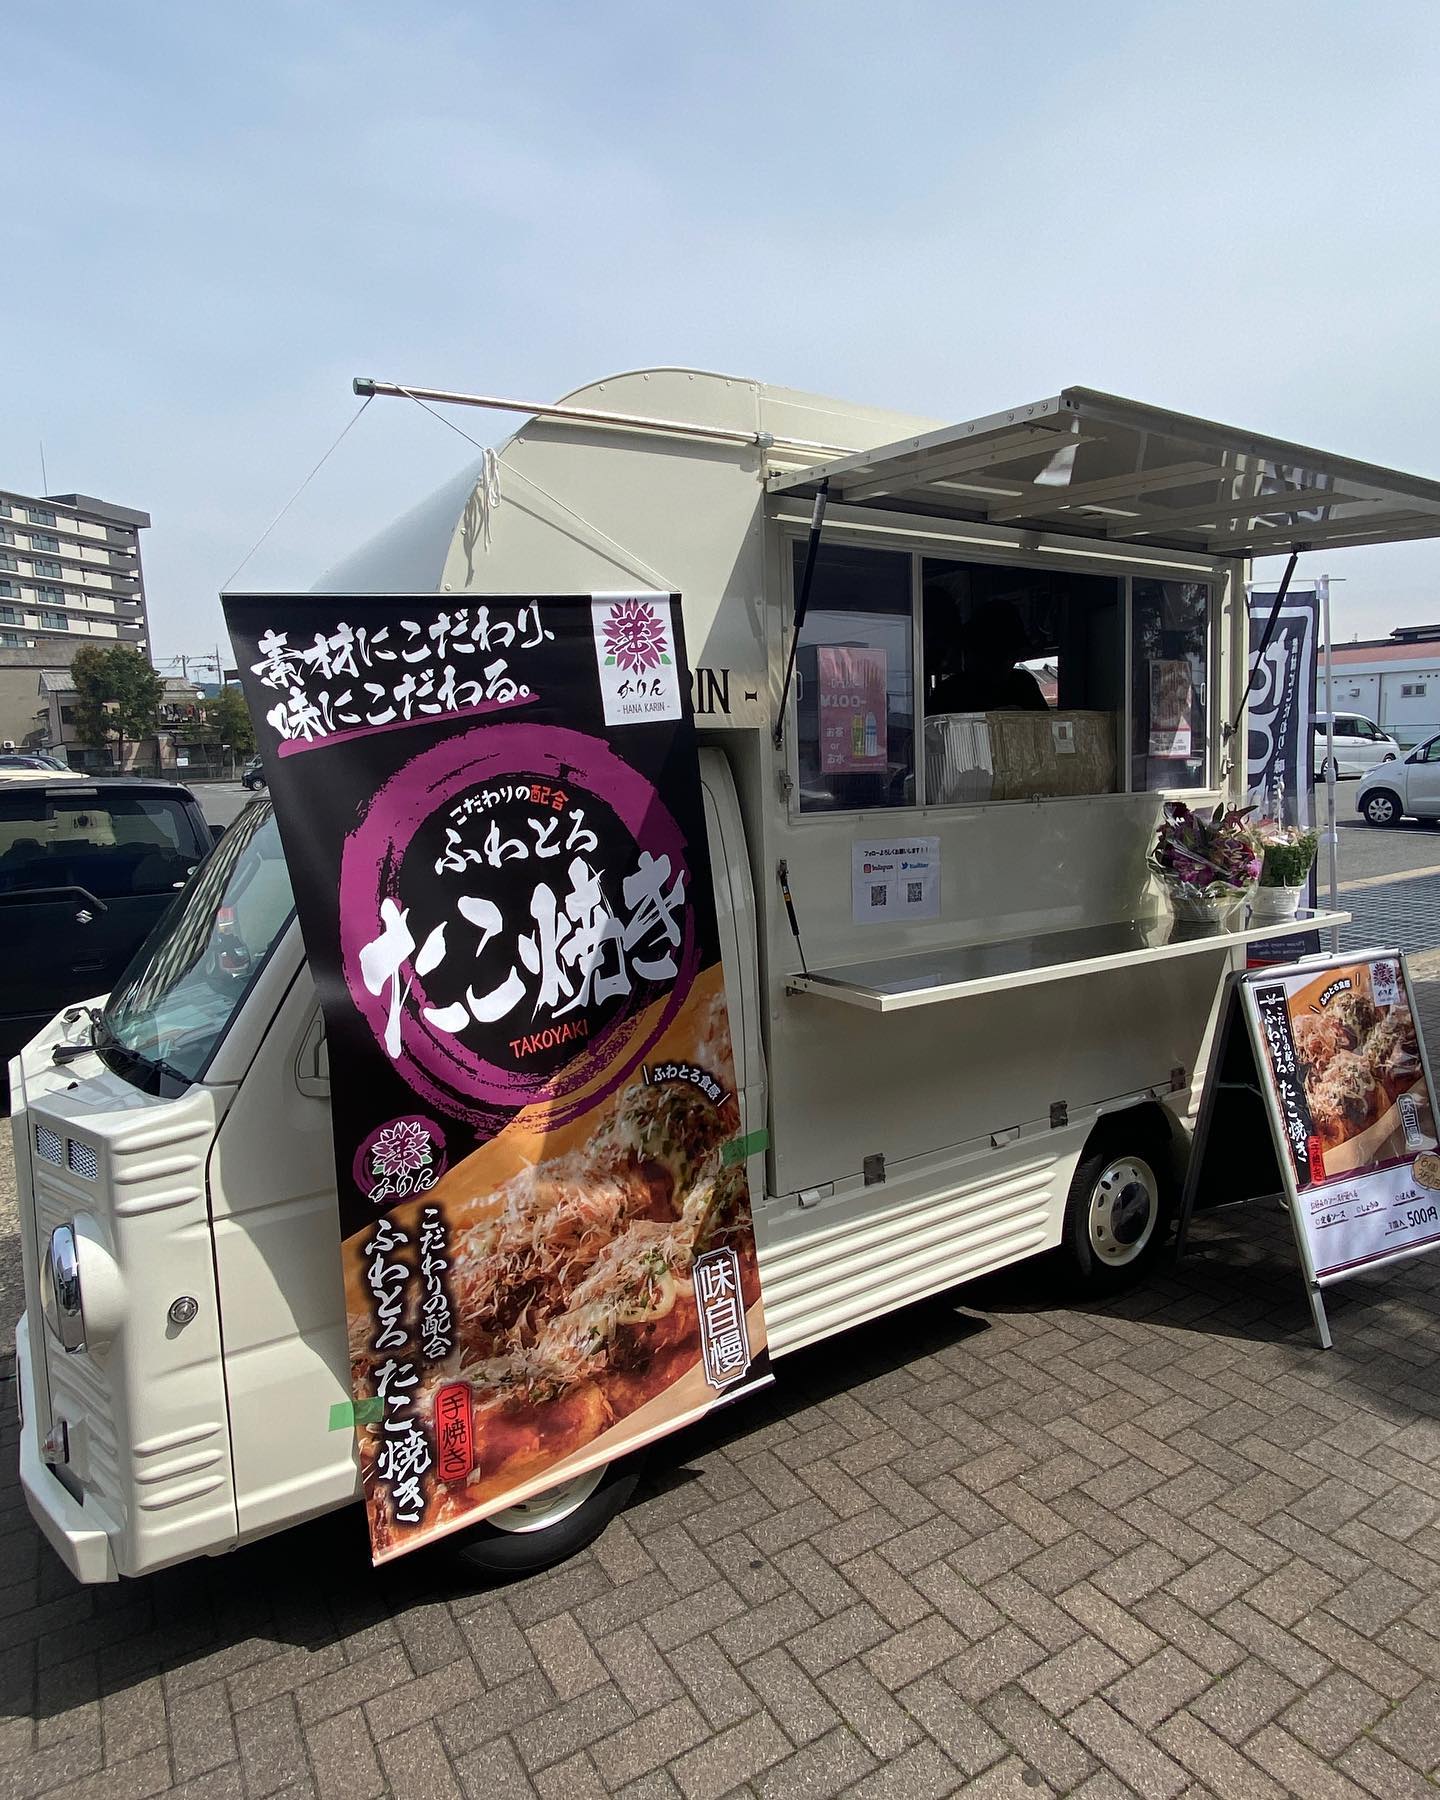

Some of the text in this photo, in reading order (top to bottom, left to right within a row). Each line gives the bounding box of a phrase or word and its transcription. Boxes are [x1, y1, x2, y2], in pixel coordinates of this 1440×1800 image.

[266, 659, 531, 742] 味にこだわる。
[616, 678, 667, 700] かりん
[622, 701, 666, 715] HANA KARIN
[830, 742, 841, 751] or
[449, 784, 570, 826] こだわりの配合
[434, 808, 599, 876] ふわとろ
[359, 850, 686, 1060] たこ焼き
[509, 1019, 589, 1060] TAKOYAKI
[654, 1064, 721, 1101] ふわとろ食感
[368, 1168, 440, 1203] かりん
[1406, 1206, 1439, 1227] 500円
[419, 1208, 452, 1359] こだわりの配合
[701, 1256, 745, 1377] 味自慢
[365, 1219, 432, 1523] ふわとろ たこ焼き
[440, 1395, 468, 1475] 手焼き
